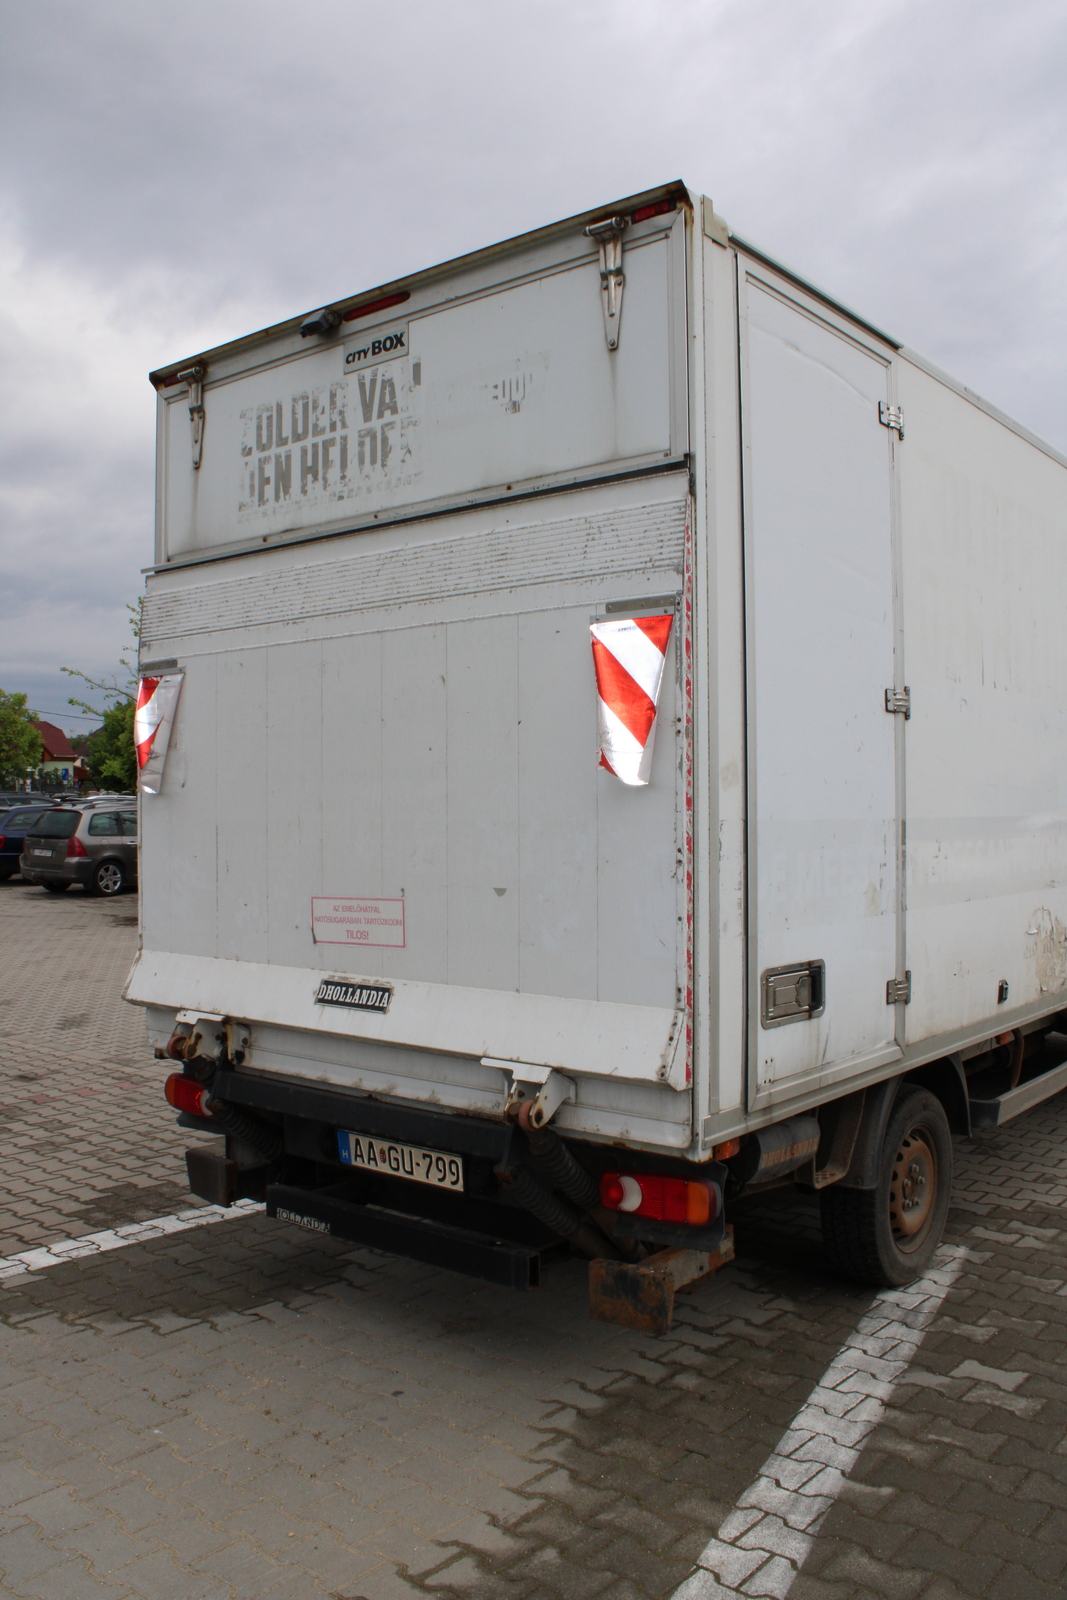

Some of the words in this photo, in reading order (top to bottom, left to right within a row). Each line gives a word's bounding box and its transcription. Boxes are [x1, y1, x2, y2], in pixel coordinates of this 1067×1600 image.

[345, 346, 371, 365] CITY
[371, 331, 406, 356] BOX
[333, 904, 340, 912] AZ
[345, 929, 369, 940] TILOS!
[318, 984, 389, 1007] DHOLLANDIA
[342, 1150, 349, 1159] H
